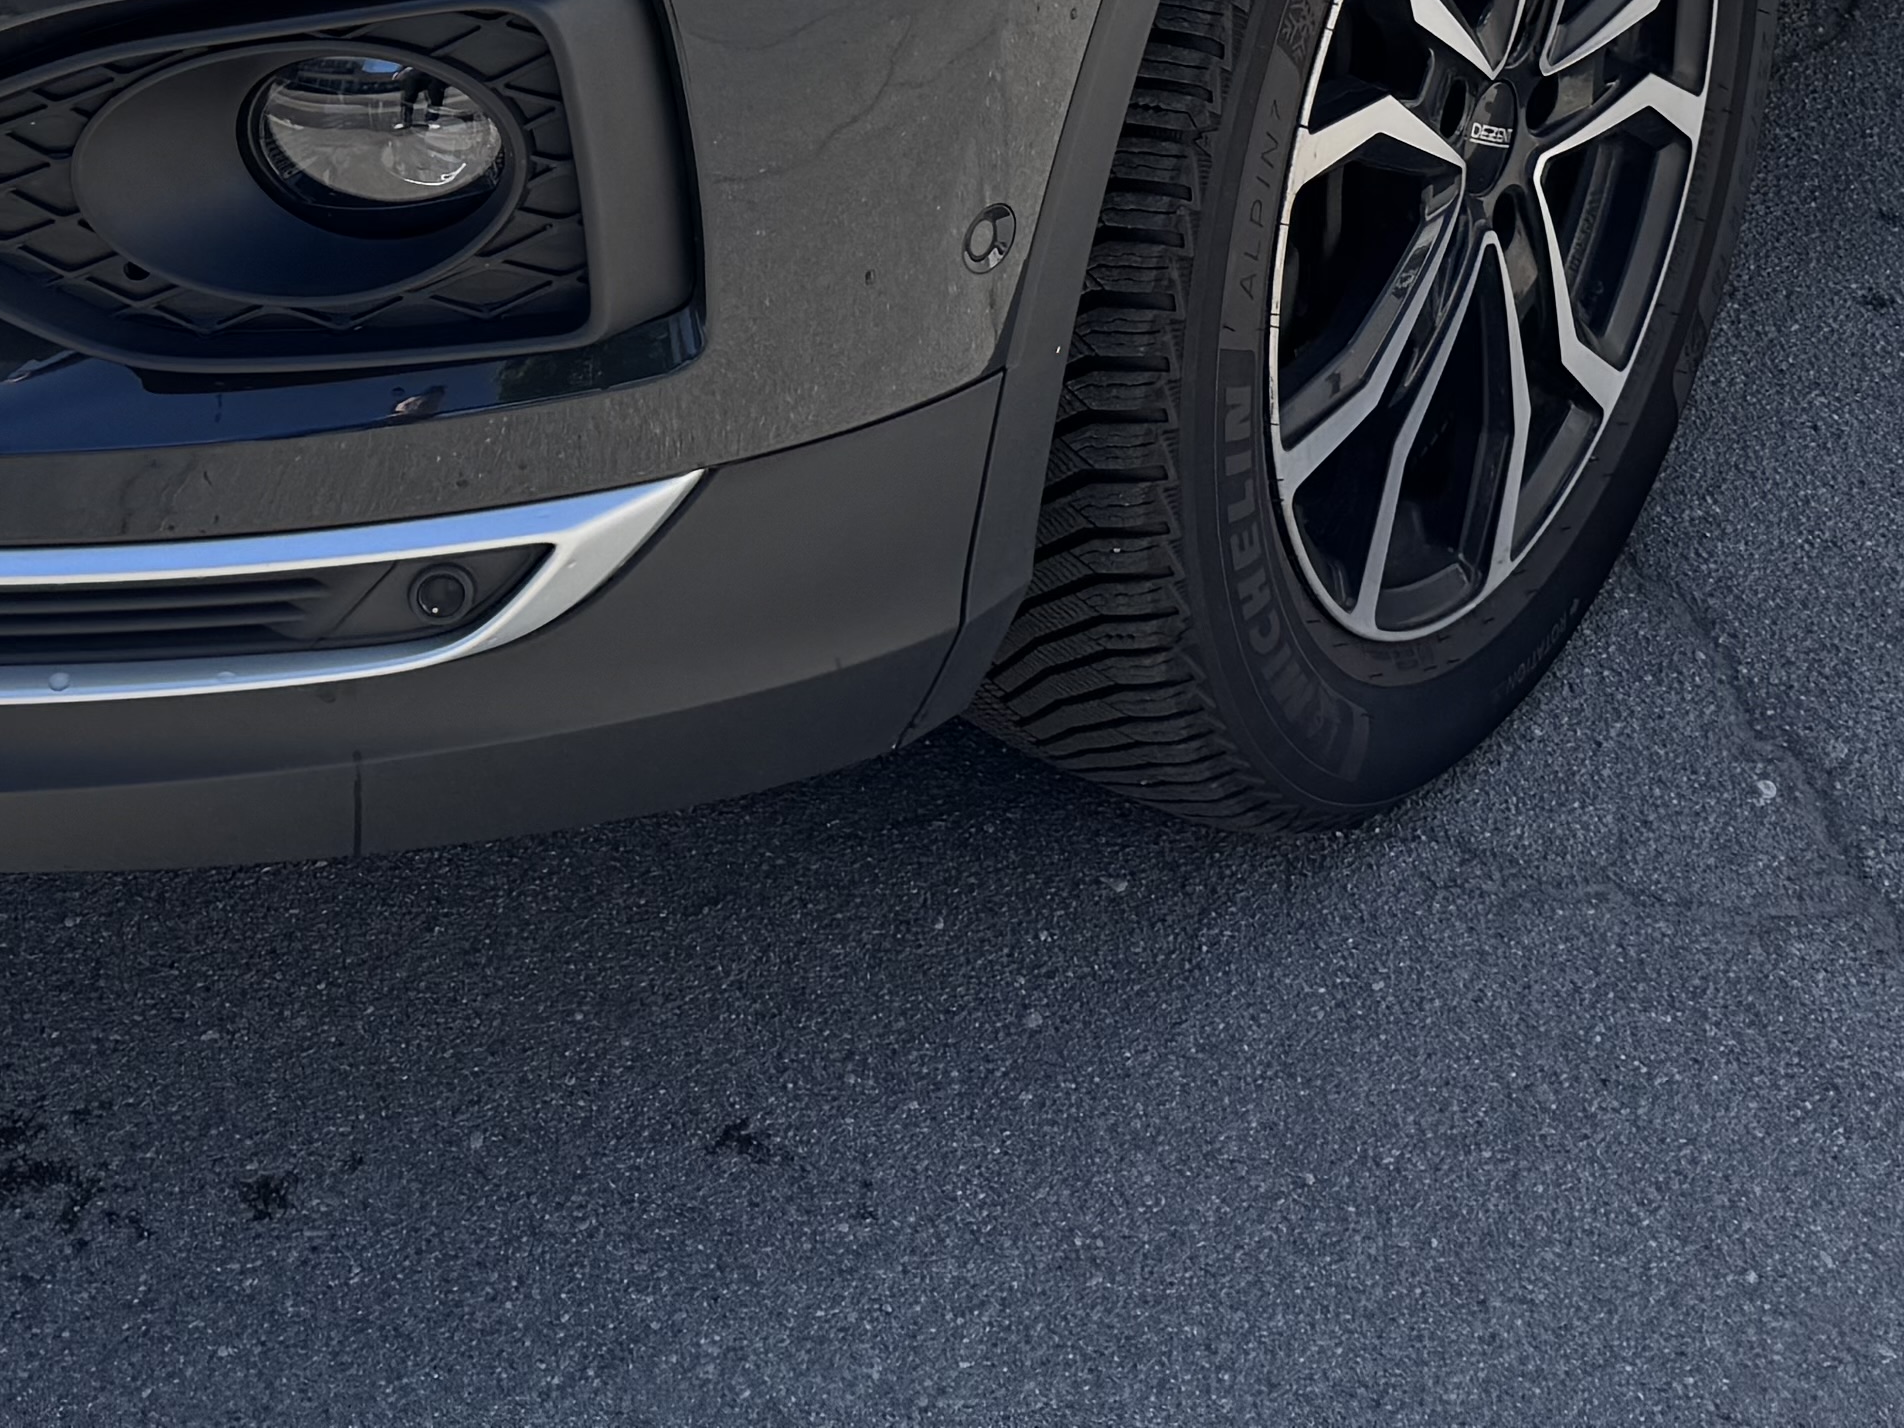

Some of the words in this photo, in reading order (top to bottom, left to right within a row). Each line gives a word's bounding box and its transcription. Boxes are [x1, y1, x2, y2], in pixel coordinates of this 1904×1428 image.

[1238, 130, 1280, 301] ALPIN
[1471, 122, 1513, 143] DEZENT
[1224, 385, 1322, 725] MICHELIN
